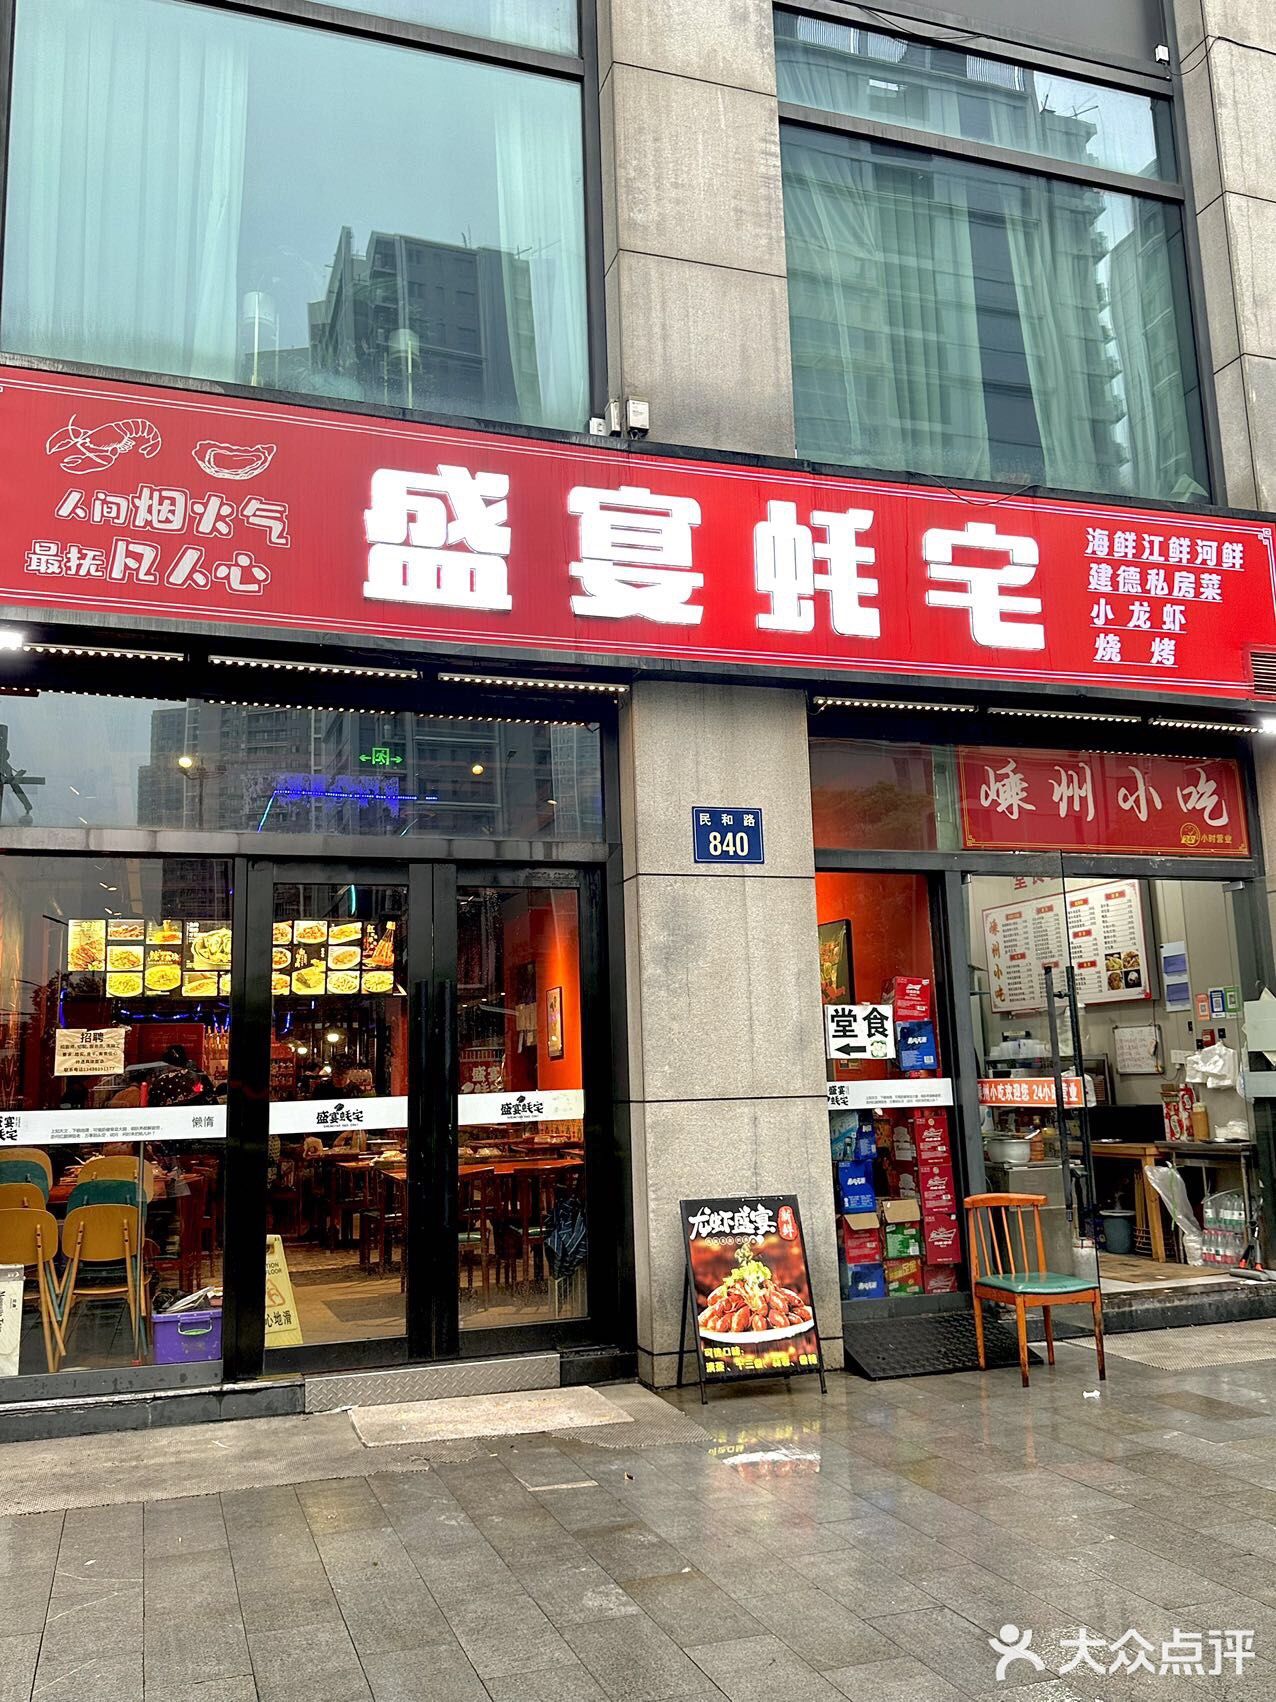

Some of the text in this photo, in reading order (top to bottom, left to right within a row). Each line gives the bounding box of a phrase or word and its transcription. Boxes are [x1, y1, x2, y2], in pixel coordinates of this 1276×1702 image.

[54, 483, 290, 548] 人间烟火气
[363, 464, 1046, 651] 盛宴蚝宅
[1085, 526, 1245, 568] 海鲜江鲜河鲜
[24, 537, 272, 595] 最抚凡人心
[1087, 563, 1223, 601] 建德私房菜
[1090, 600, 1187, 632] 小龙虾
[1094, 634, 1178, 667] 烧烤
[980, 758, 1229, 827] 嵊州小吃
[700, 813, 755, 827] 民和路
[709, 832, 749, 857] 840
[81, 1032, 104, 1043] 招聘
[831, 1007, 889, 1039] 堂食
[192, 1116, 214, 1128] 懒惰
[688, 1203, 777, 1240] 龙虾盛宴
[265, 1310, 292, 1328] 心地滑
